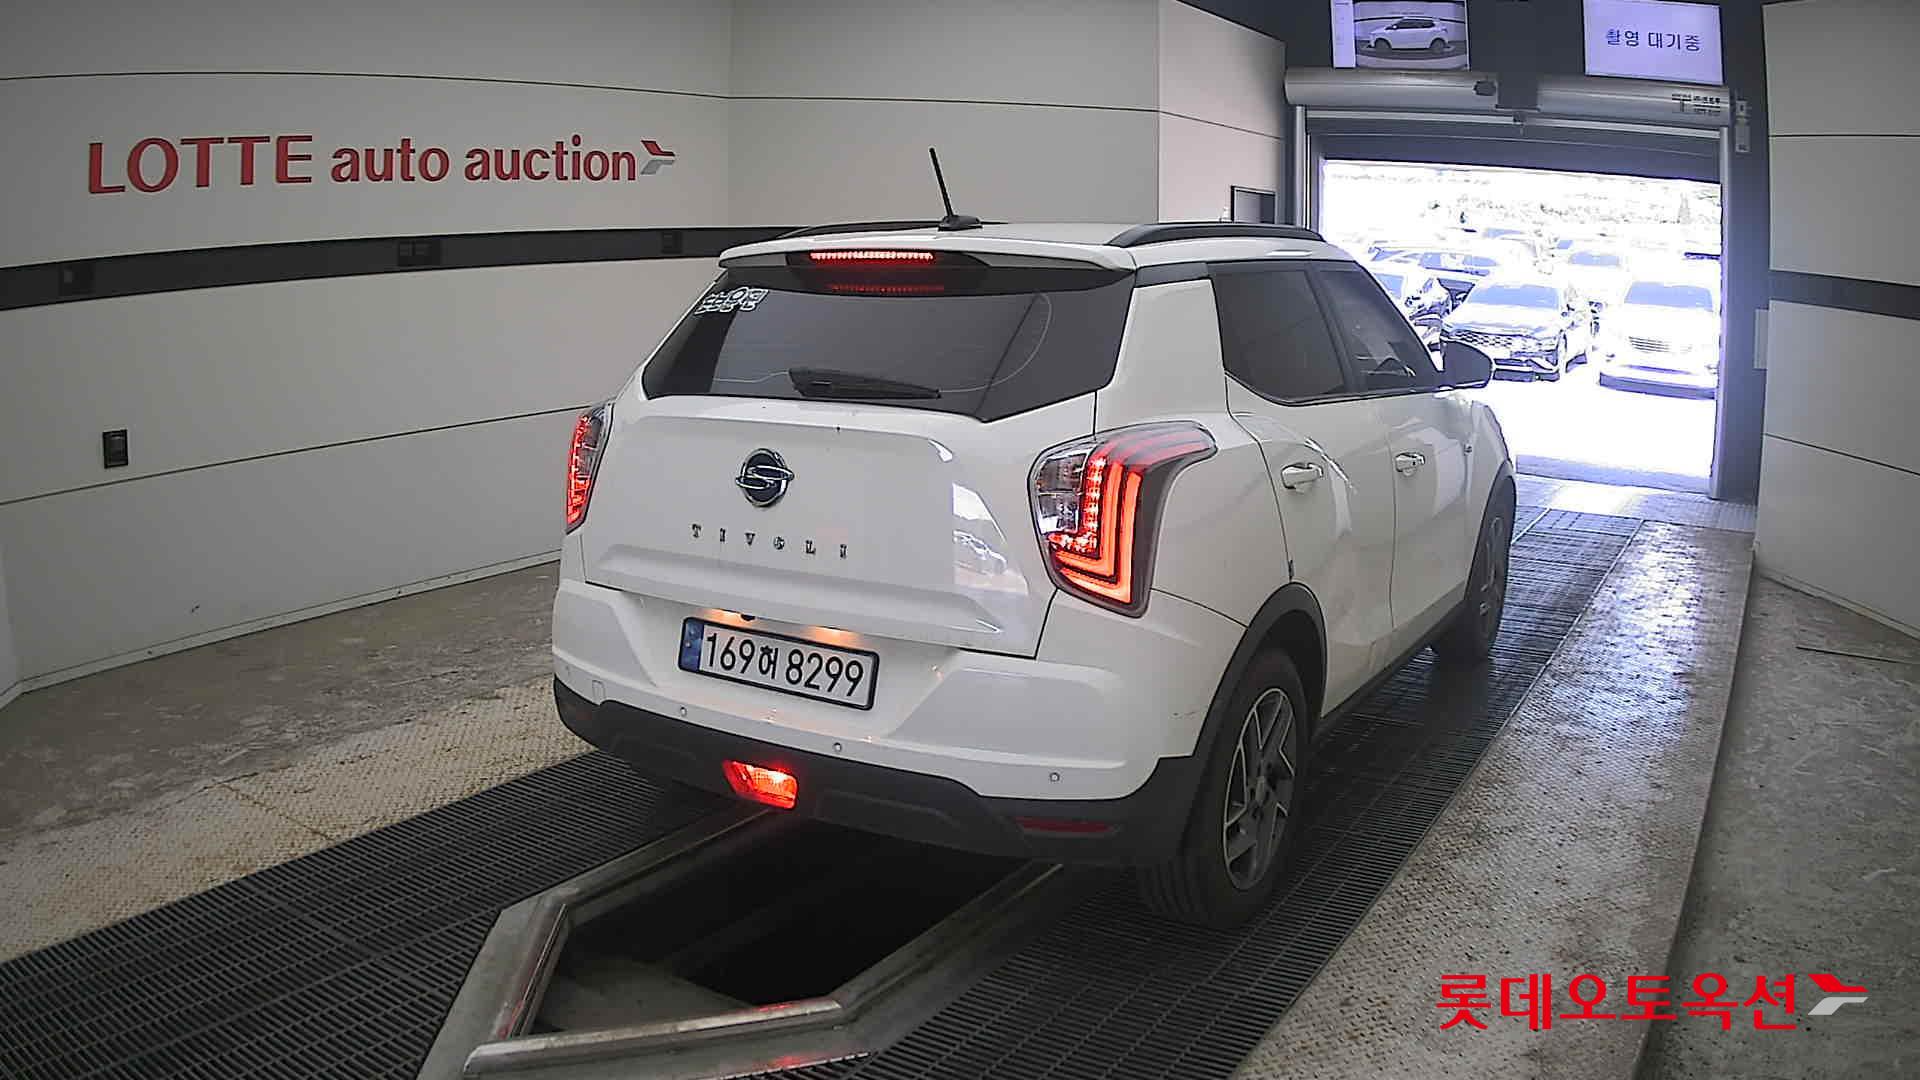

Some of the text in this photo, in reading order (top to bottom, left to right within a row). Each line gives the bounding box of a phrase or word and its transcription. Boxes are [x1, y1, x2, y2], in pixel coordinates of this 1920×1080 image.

[1648, 31, 1700, 52] 대기중
[88, 134, 638, 195] LOTTE auto auction
[692, 523, 848, 559] TIVOLI
[785, 649, 865, 697] 8299
